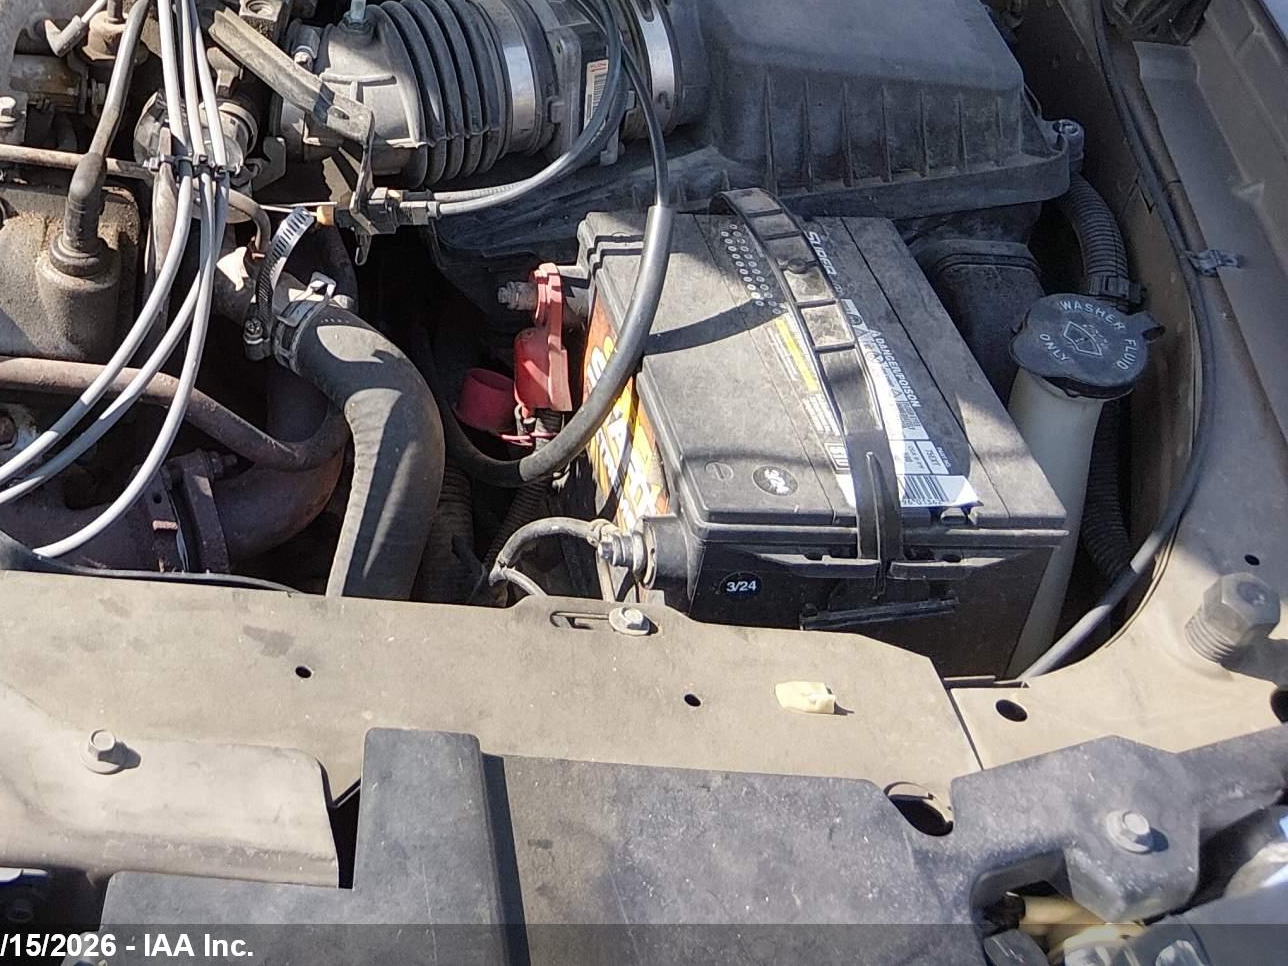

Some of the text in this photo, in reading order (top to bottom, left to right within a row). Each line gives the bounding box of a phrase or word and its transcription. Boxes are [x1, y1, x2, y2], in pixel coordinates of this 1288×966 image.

[1039, 332, 1072, 362] ONLY
[1059, 300, 1138, 371] WASHER FLUID
[875, 334, 922, 408] DANGER/POISON
[725, 579, 757, 593] 3/24
